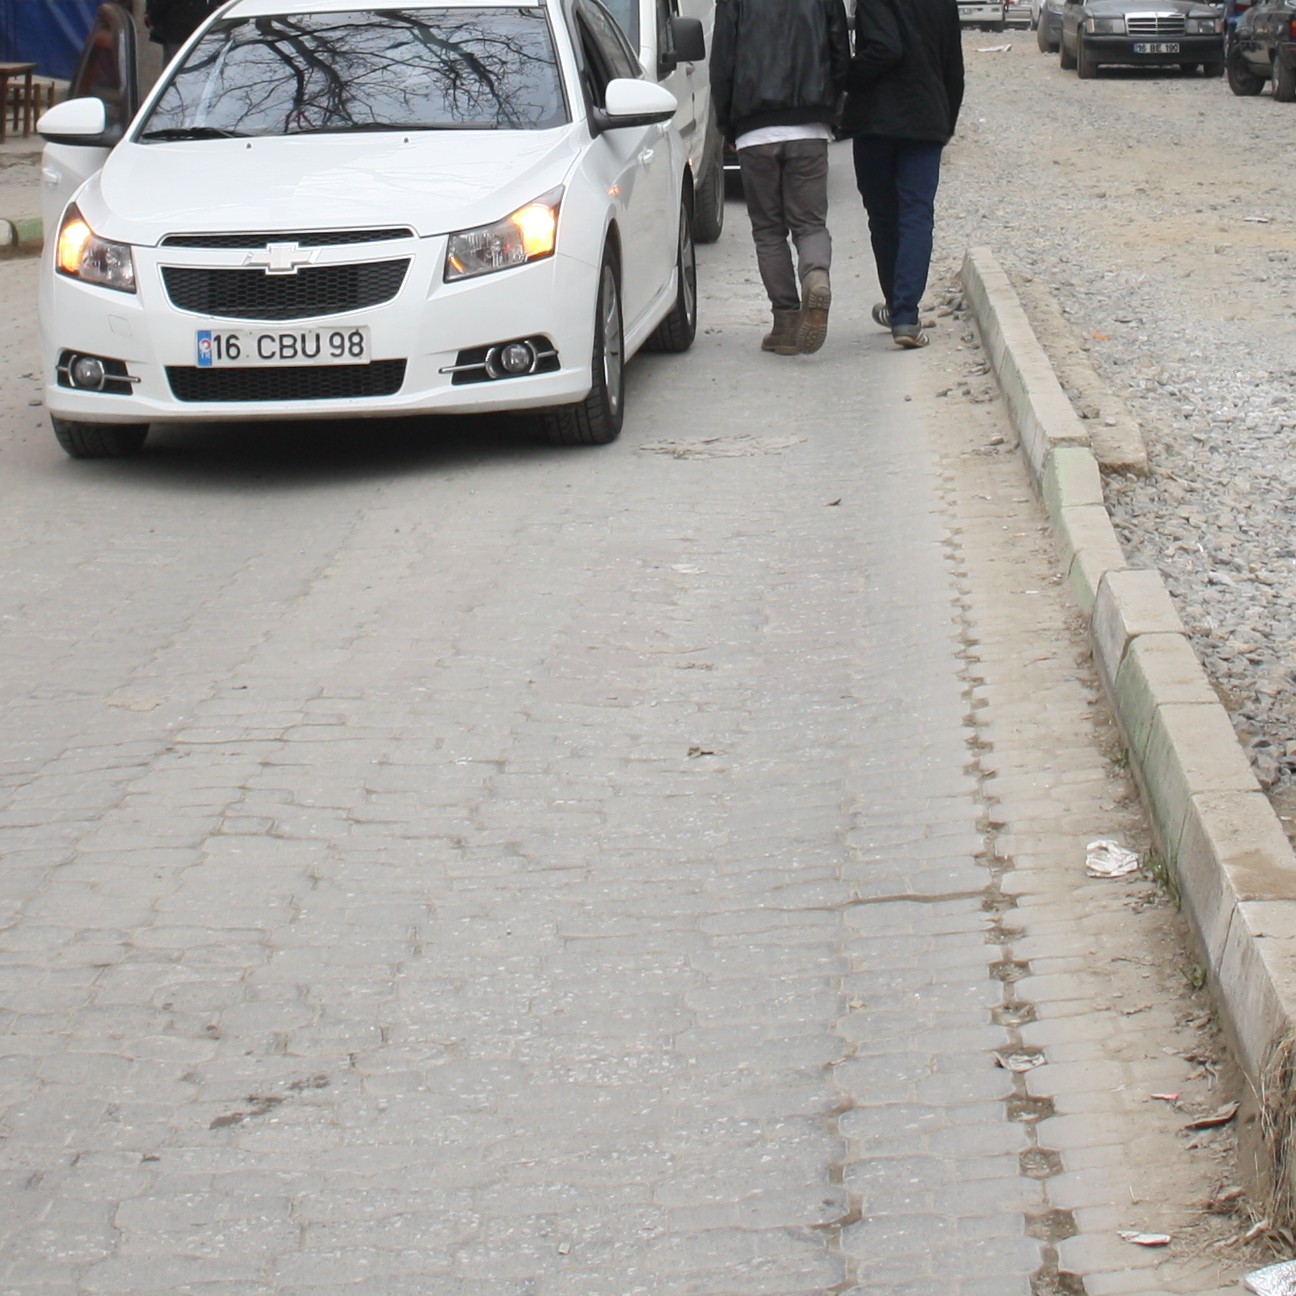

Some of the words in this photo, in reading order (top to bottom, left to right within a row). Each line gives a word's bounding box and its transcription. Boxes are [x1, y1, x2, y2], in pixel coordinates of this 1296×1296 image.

[212, 333, 241, 361] 16
[257, 331, 322, 361] CBU
[329, 330, 365, 359] 98
